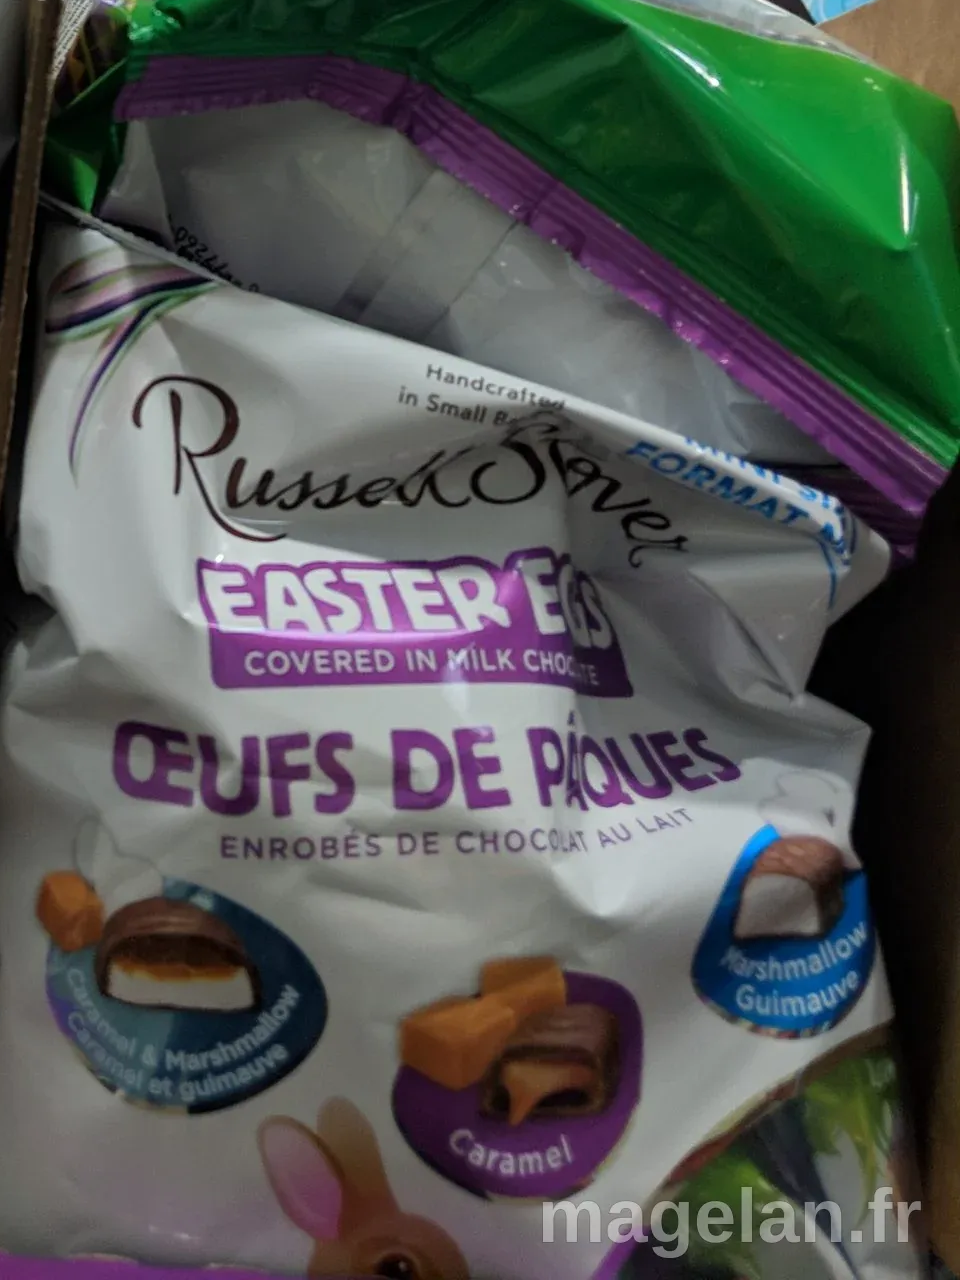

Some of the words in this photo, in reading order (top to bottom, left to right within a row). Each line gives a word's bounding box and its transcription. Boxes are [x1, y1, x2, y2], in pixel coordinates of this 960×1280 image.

[397, 385, 419, 407] in
[425, 393, 488, 424] Small
[425, 363, 568, 412] Handcrafted
[625, 440, 811, 528] FORMAT
[201, 561, 513, 637] EASTER
[243, 647, 396, 677] COVERED
[405, 649, 438, 673] IN
[446, 645, 517, 673] MILK
[110, 719, 357, 820] ŒUFS
[390, 725, 513, 813] DE
[219, 823, 383, 861] ENROBÉS
[397, 831, 441, 857] DE
[596, 822, 634, 850] AU
[636, 806, 696, 836] LAIT
[719, 920, 869, 983] Marshmallow
[66, 968, 138, 1058] Caramel
[142, 1043, 158, 1069] &
[164, 983, 302, 1073] Marshmallow
[735, 969, 860, 1017] Guimauve
[148, 1075, 175, 1098] et
[178, 1042, 290, 1104] guimauve
[448, 1127, 577, 1180] Caramel
